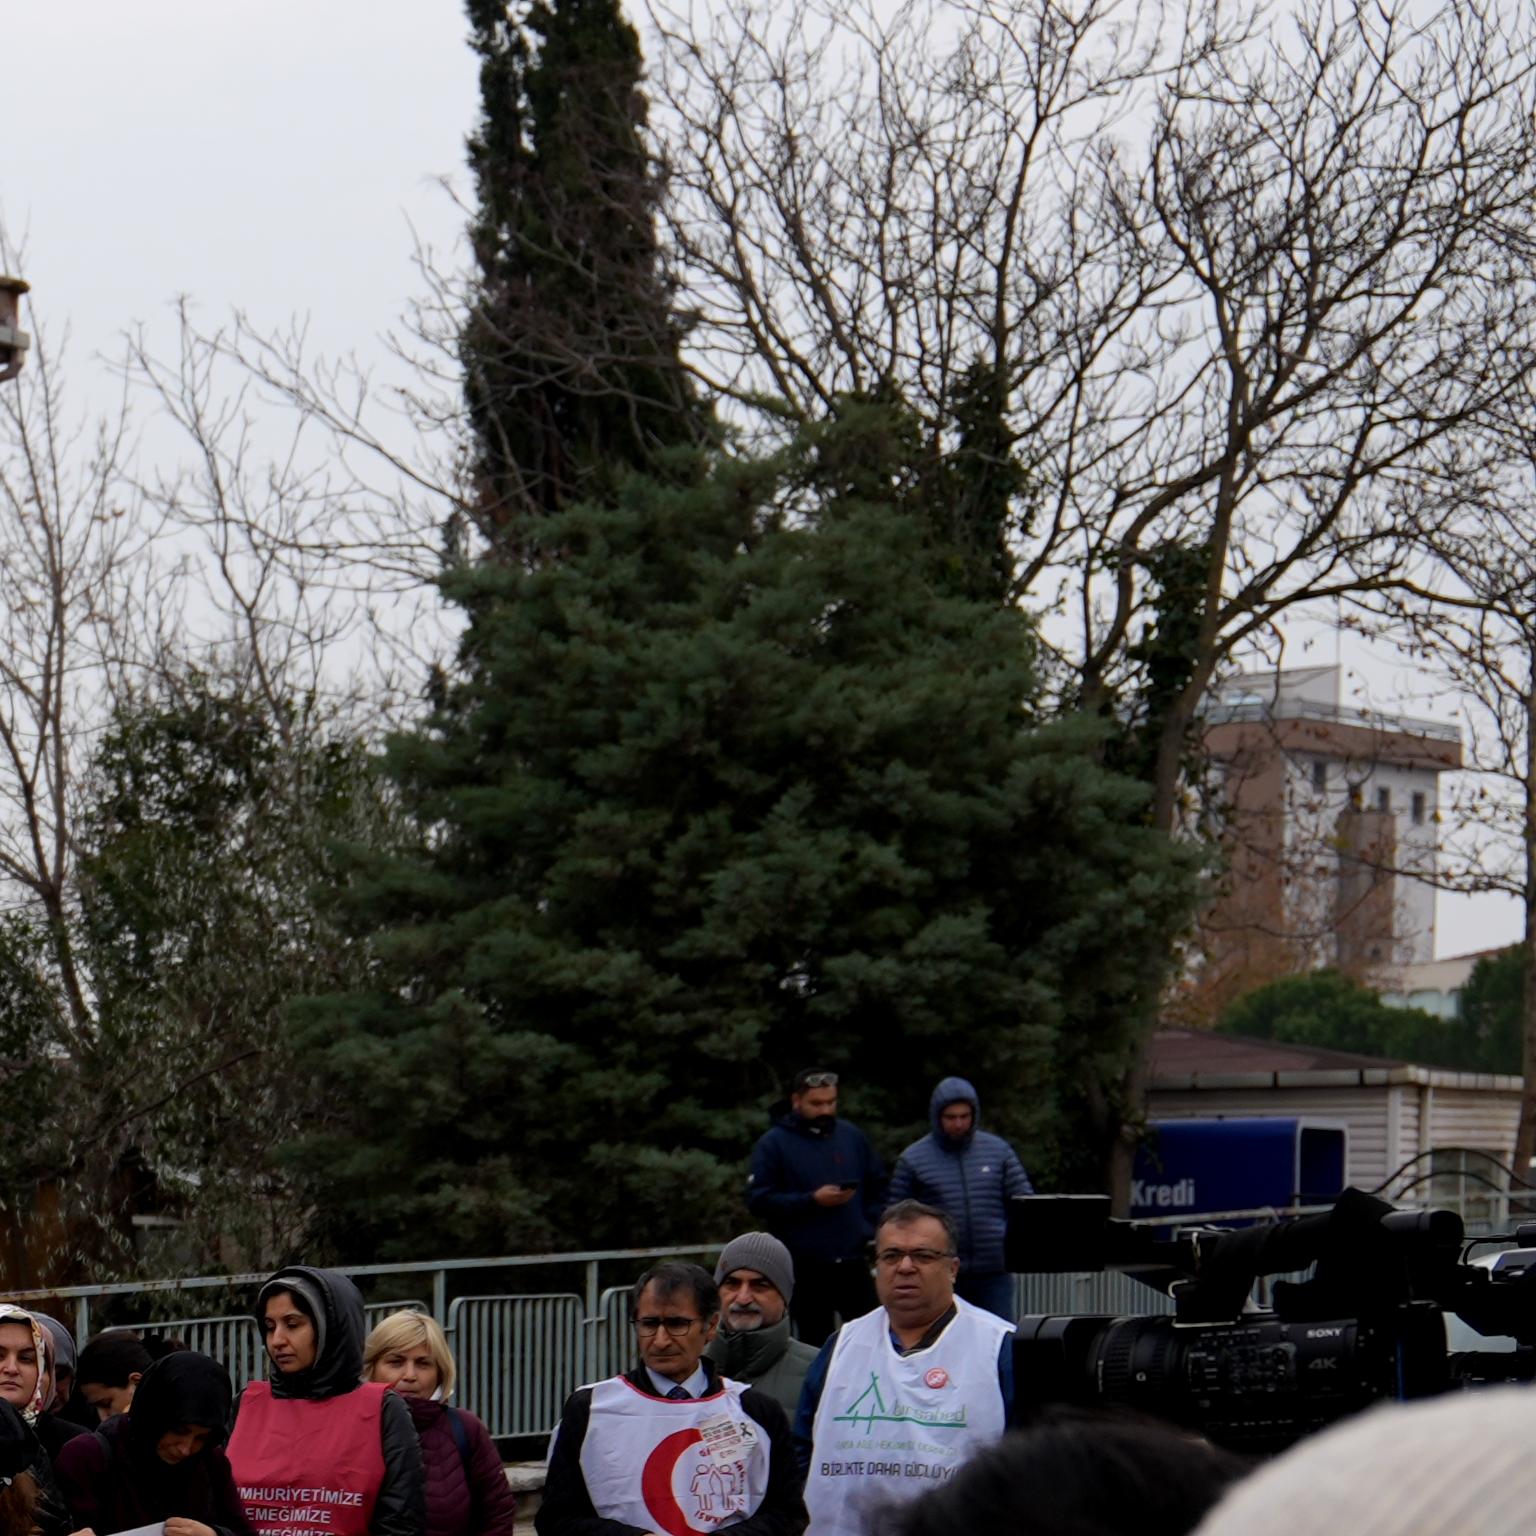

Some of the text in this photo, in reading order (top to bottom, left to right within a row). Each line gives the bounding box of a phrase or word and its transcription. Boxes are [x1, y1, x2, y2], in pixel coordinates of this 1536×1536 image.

[1129, 1177, 1196, 1208] Kredi
[1306, 1328, 1342, 1339] SONY
[866, 1461, 901, 1477] DAHA
[237, 1485, 364, 1508] MHURİYETİMİZE
